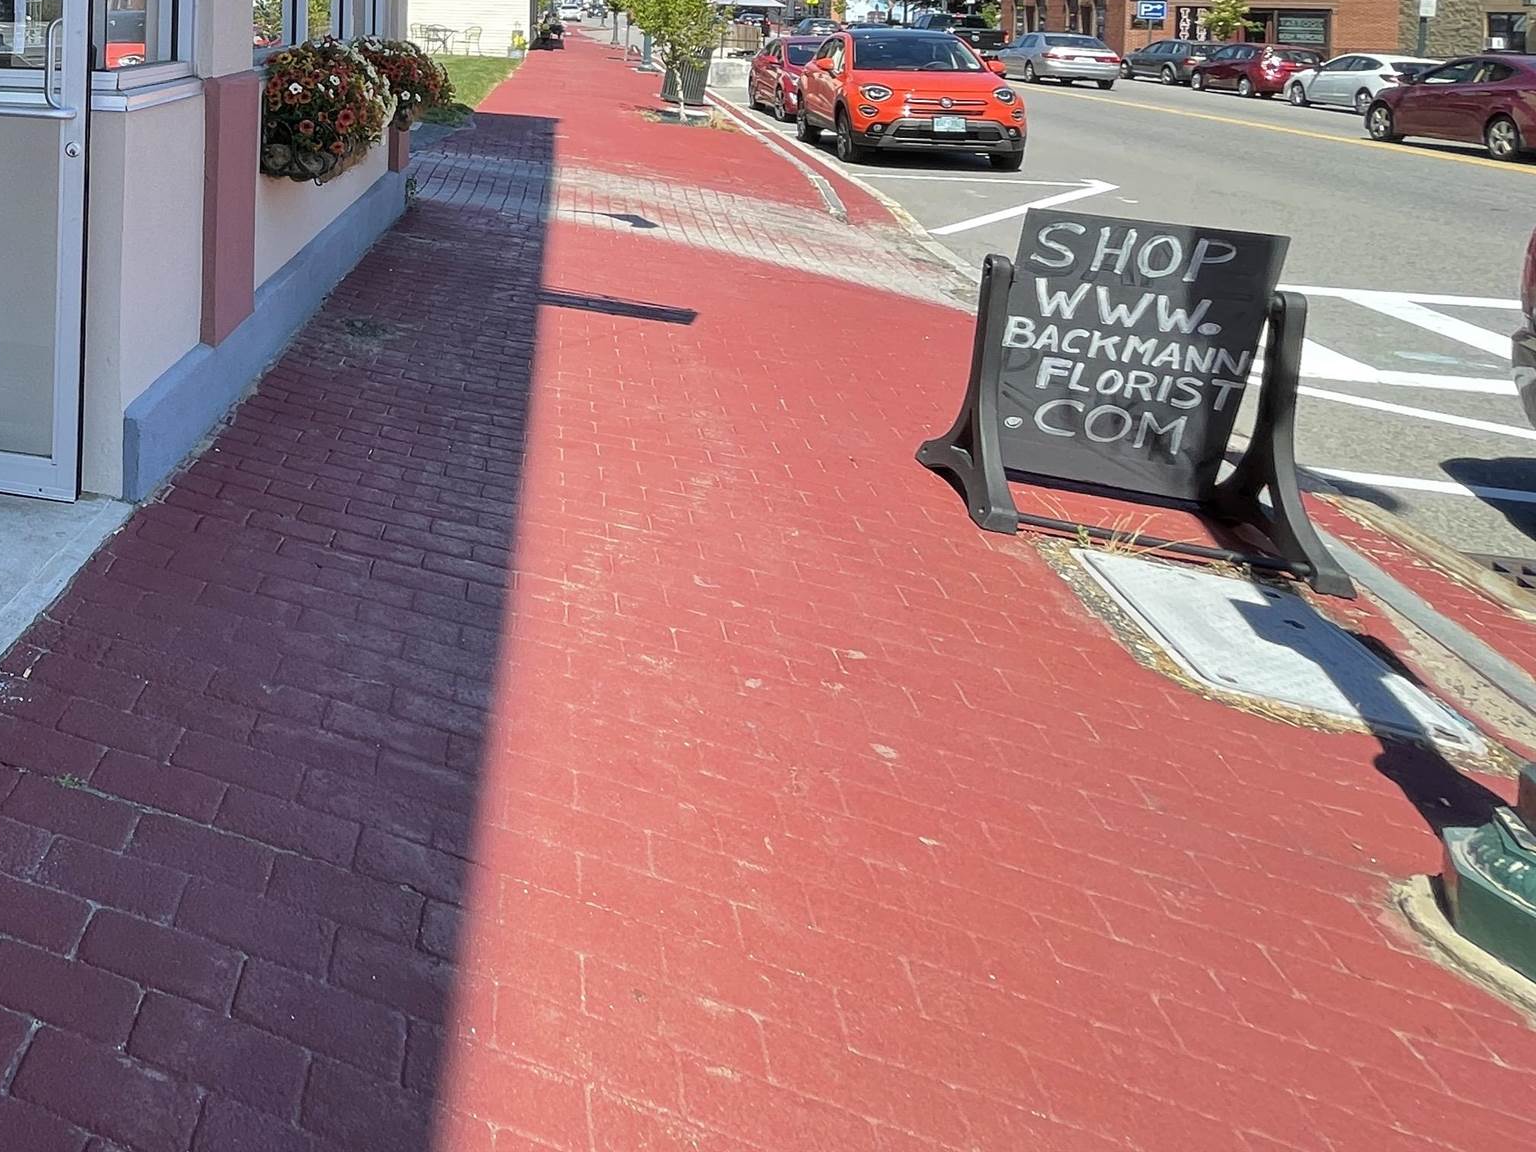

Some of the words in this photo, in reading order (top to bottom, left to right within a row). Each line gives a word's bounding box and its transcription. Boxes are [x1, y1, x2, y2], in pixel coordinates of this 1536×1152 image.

[1029, 221, 1237, 283] SHOP
[1035, 278, 1222, 336] WWW.
[1001, 315, 1254, 376] BACKMANN
[1035, 356, 1244, 412] FLORIST
[1004, 398, 1189, 456] .COM
